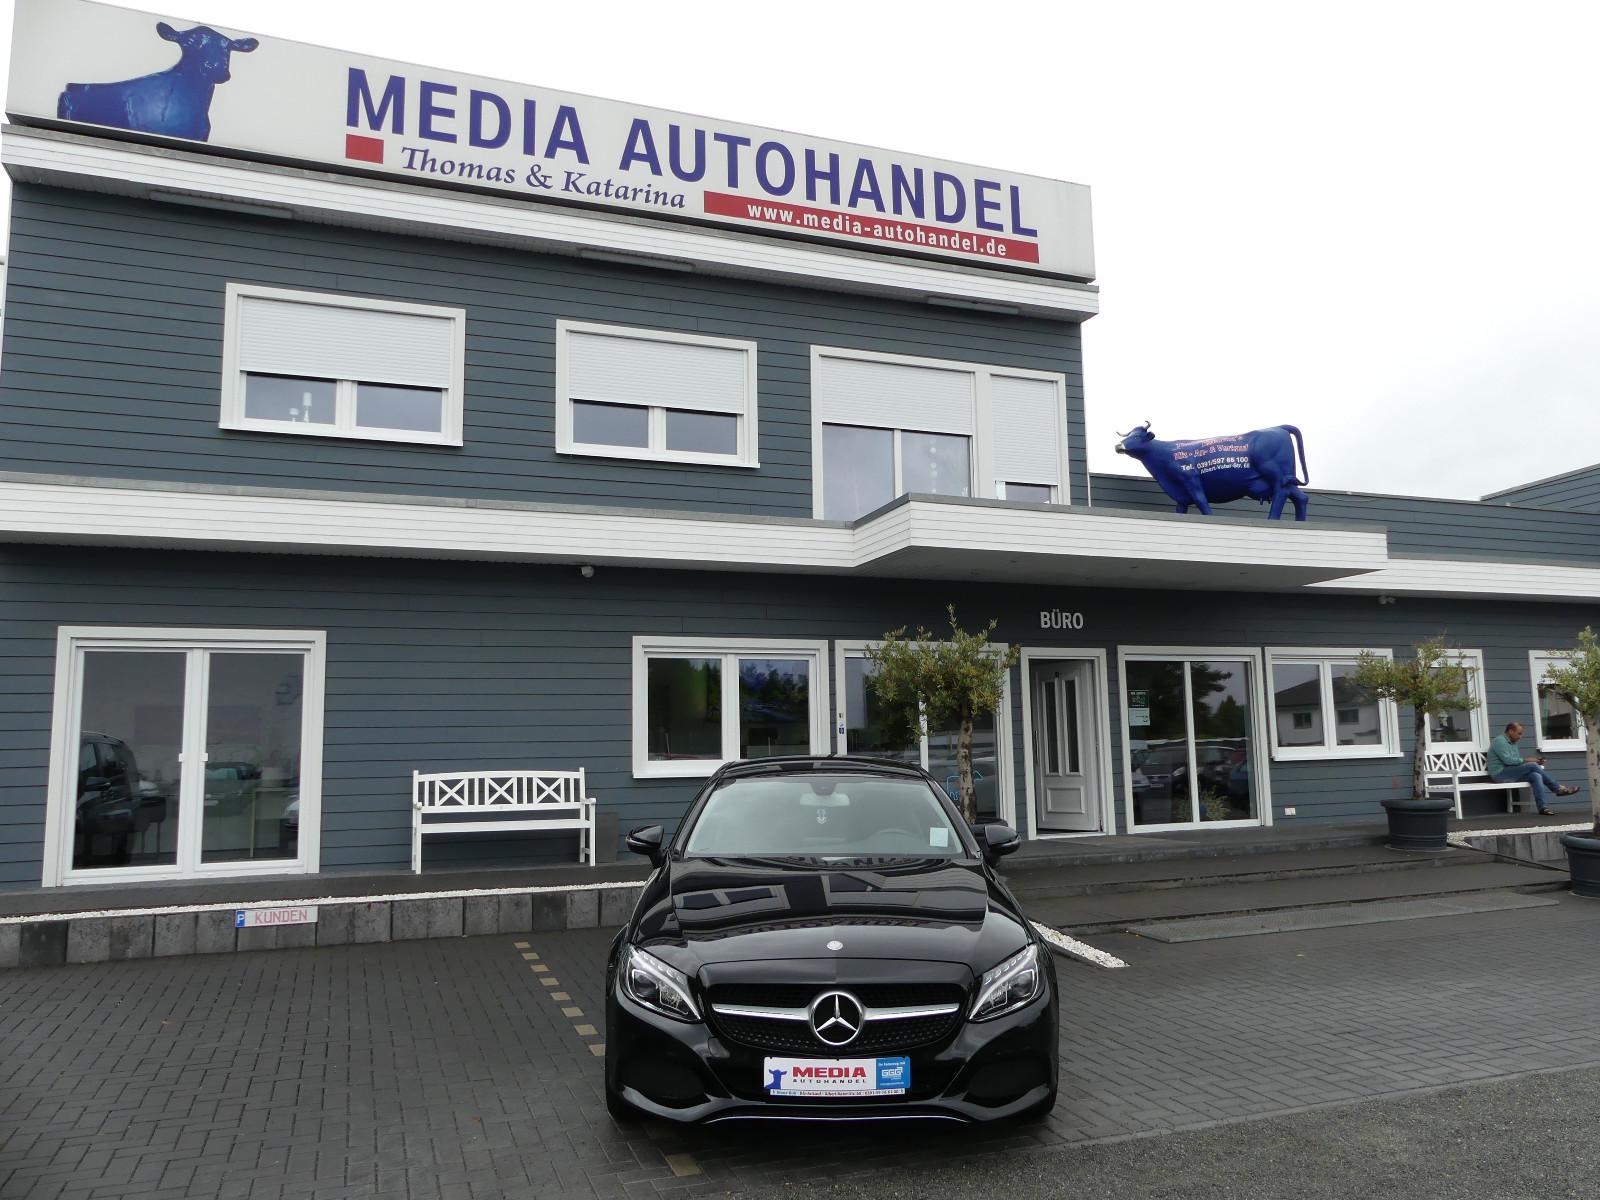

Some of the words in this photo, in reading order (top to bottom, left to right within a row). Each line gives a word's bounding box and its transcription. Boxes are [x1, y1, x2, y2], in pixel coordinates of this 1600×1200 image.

[346, 67, 590, 165] MEDIA
[619, 117, 1038, 238] AUTOHANDEL
[401, 146, 516, 185] Thomas
[526, 163, 553, 190] &
[560, 171, 686, 209] Katarina
[747, 202, 1007, 257] www.media-autohandel.de
[1040, 609, 1084, 629] BÜRO
[237, 914, 245, 924] P
[255, 909, 308, 925] KUNDEN
[792, 1066, 867, 1078] MEDIA
